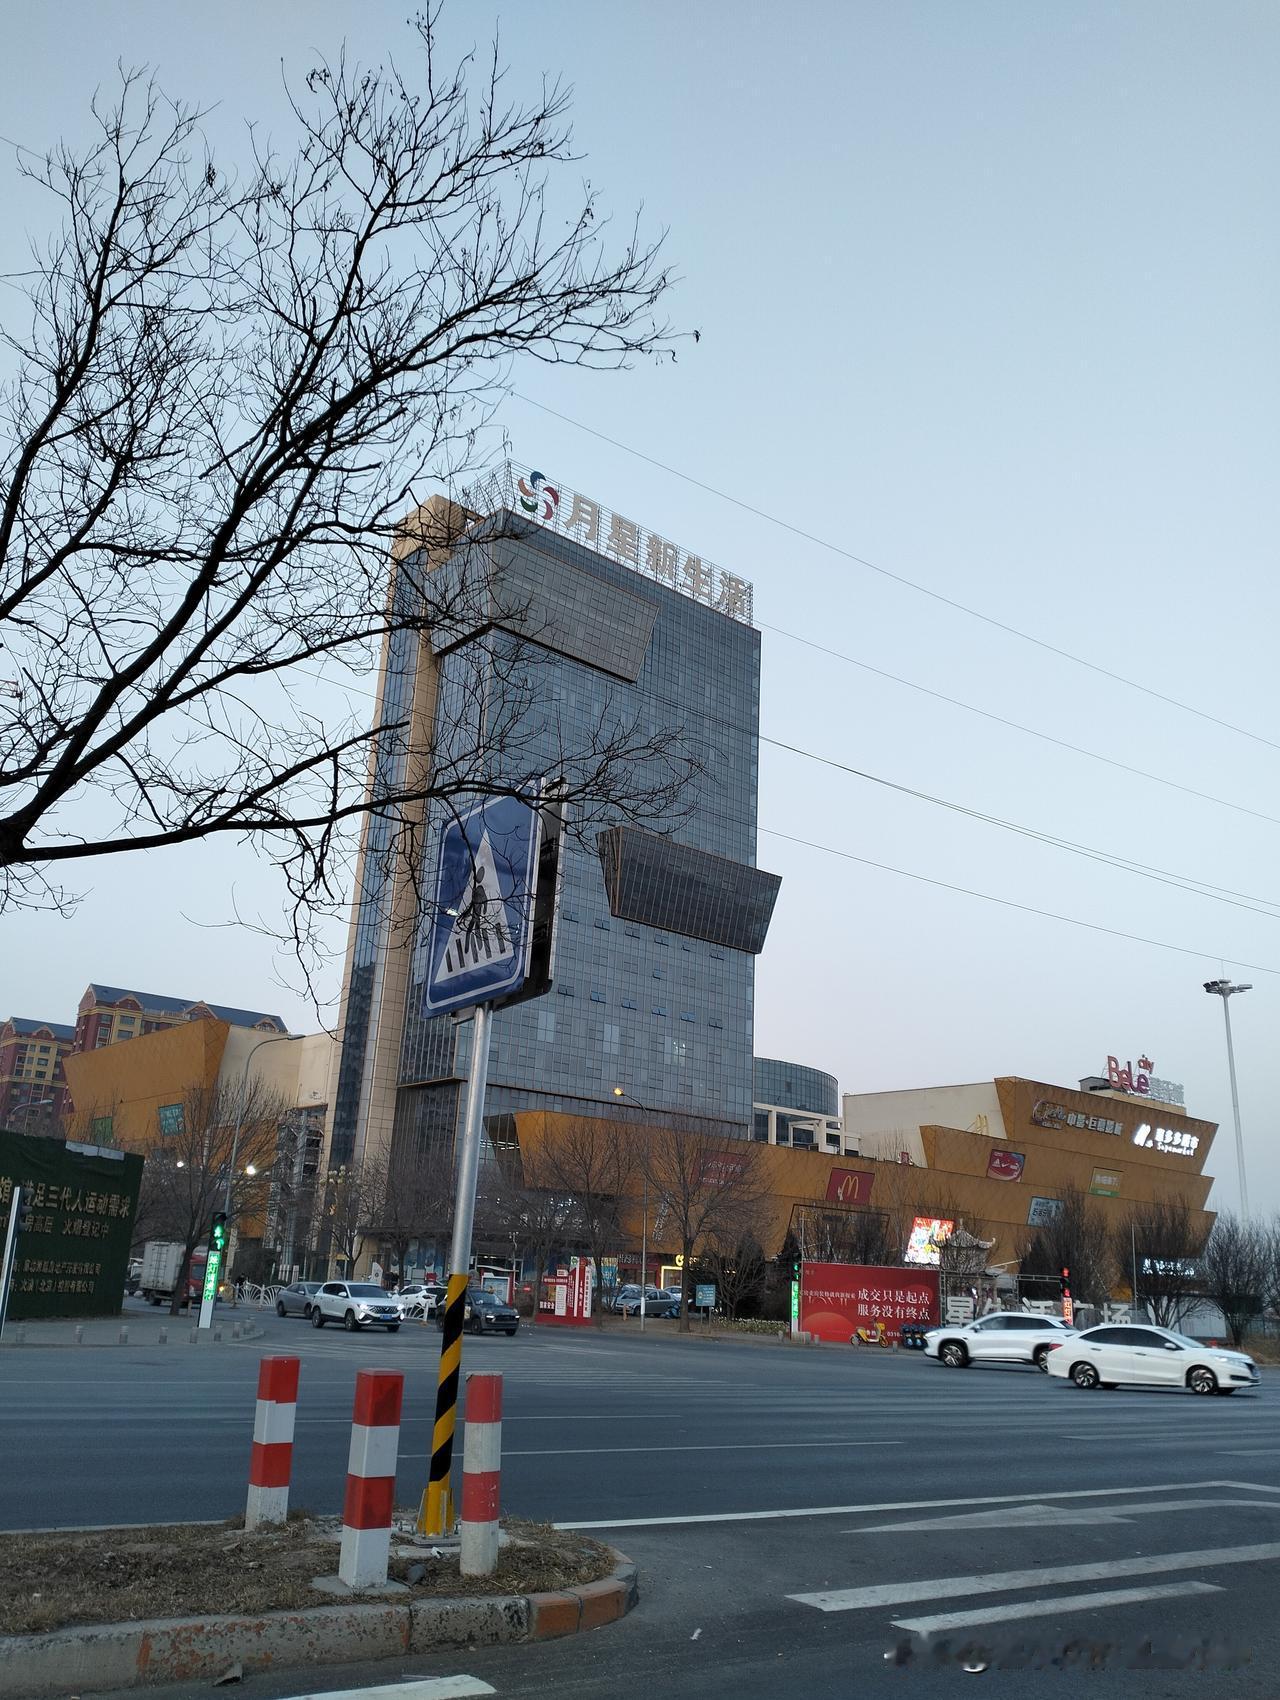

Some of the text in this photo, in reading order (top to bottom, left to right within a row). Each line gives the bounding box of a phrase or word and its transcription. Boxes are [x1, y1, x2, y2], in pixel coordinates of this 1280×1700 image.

[564, 494, 747, 613] 月星新生活
[857, 1288, 931, 1305] 成交只是起点
[857, 1303, 931, 1320] 服务没有终点
